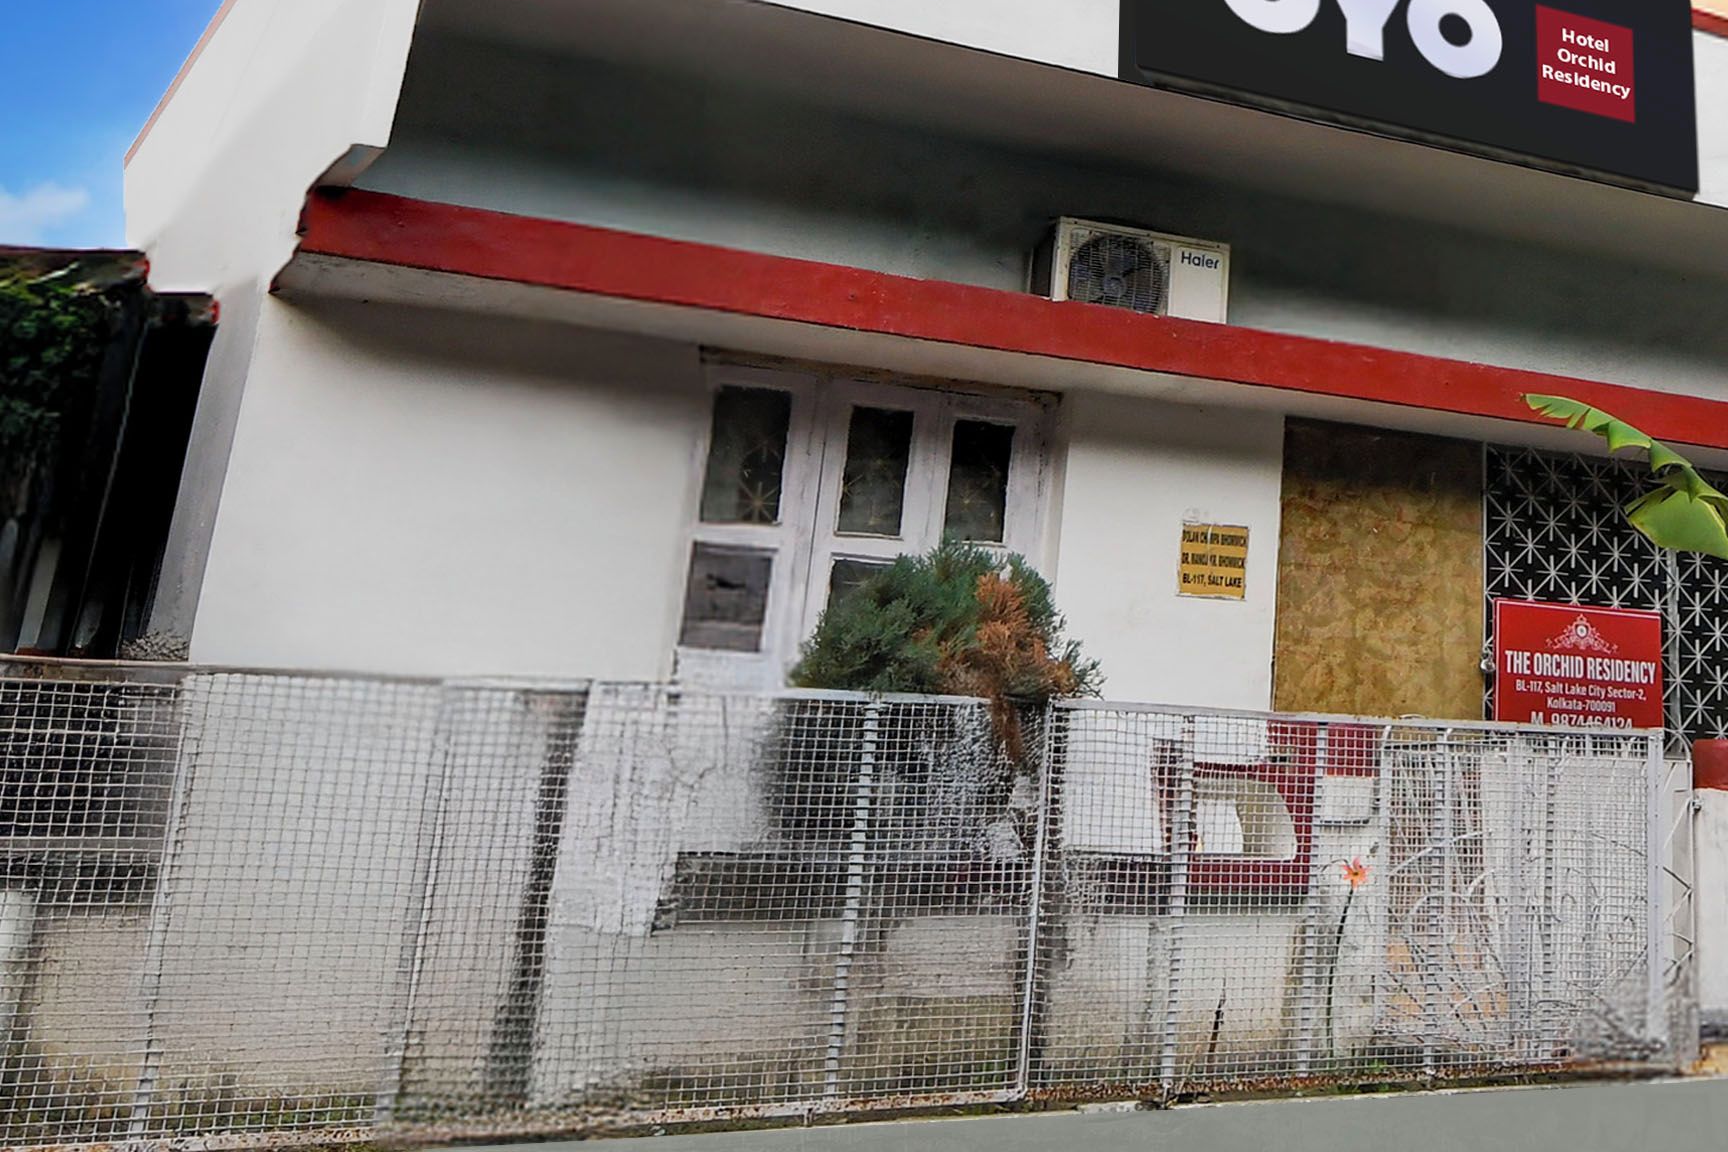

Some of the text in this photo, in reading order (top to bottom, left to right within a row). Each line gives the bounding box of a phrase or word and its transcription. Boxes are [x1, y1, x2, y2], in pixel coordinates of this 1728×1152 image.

[1562, 28, 1609, 52] Hotel
[1557, 48, 1616, 74] Orchid
[1542, 63, 1631, 99] Residency
[1181, 251, 1220, 269] Haier
[1208, 574, 1224, 586] SALT
[1225, 576, 1242, 588] LAKE
[1505, 650, 1656, 684] THE ORCHID RESIDENCY
[1516, 679, 1647, 701] BL-117, Salt Lake City Sector-2,
[1547, 696, 1616, 713] Kolkata-700091
